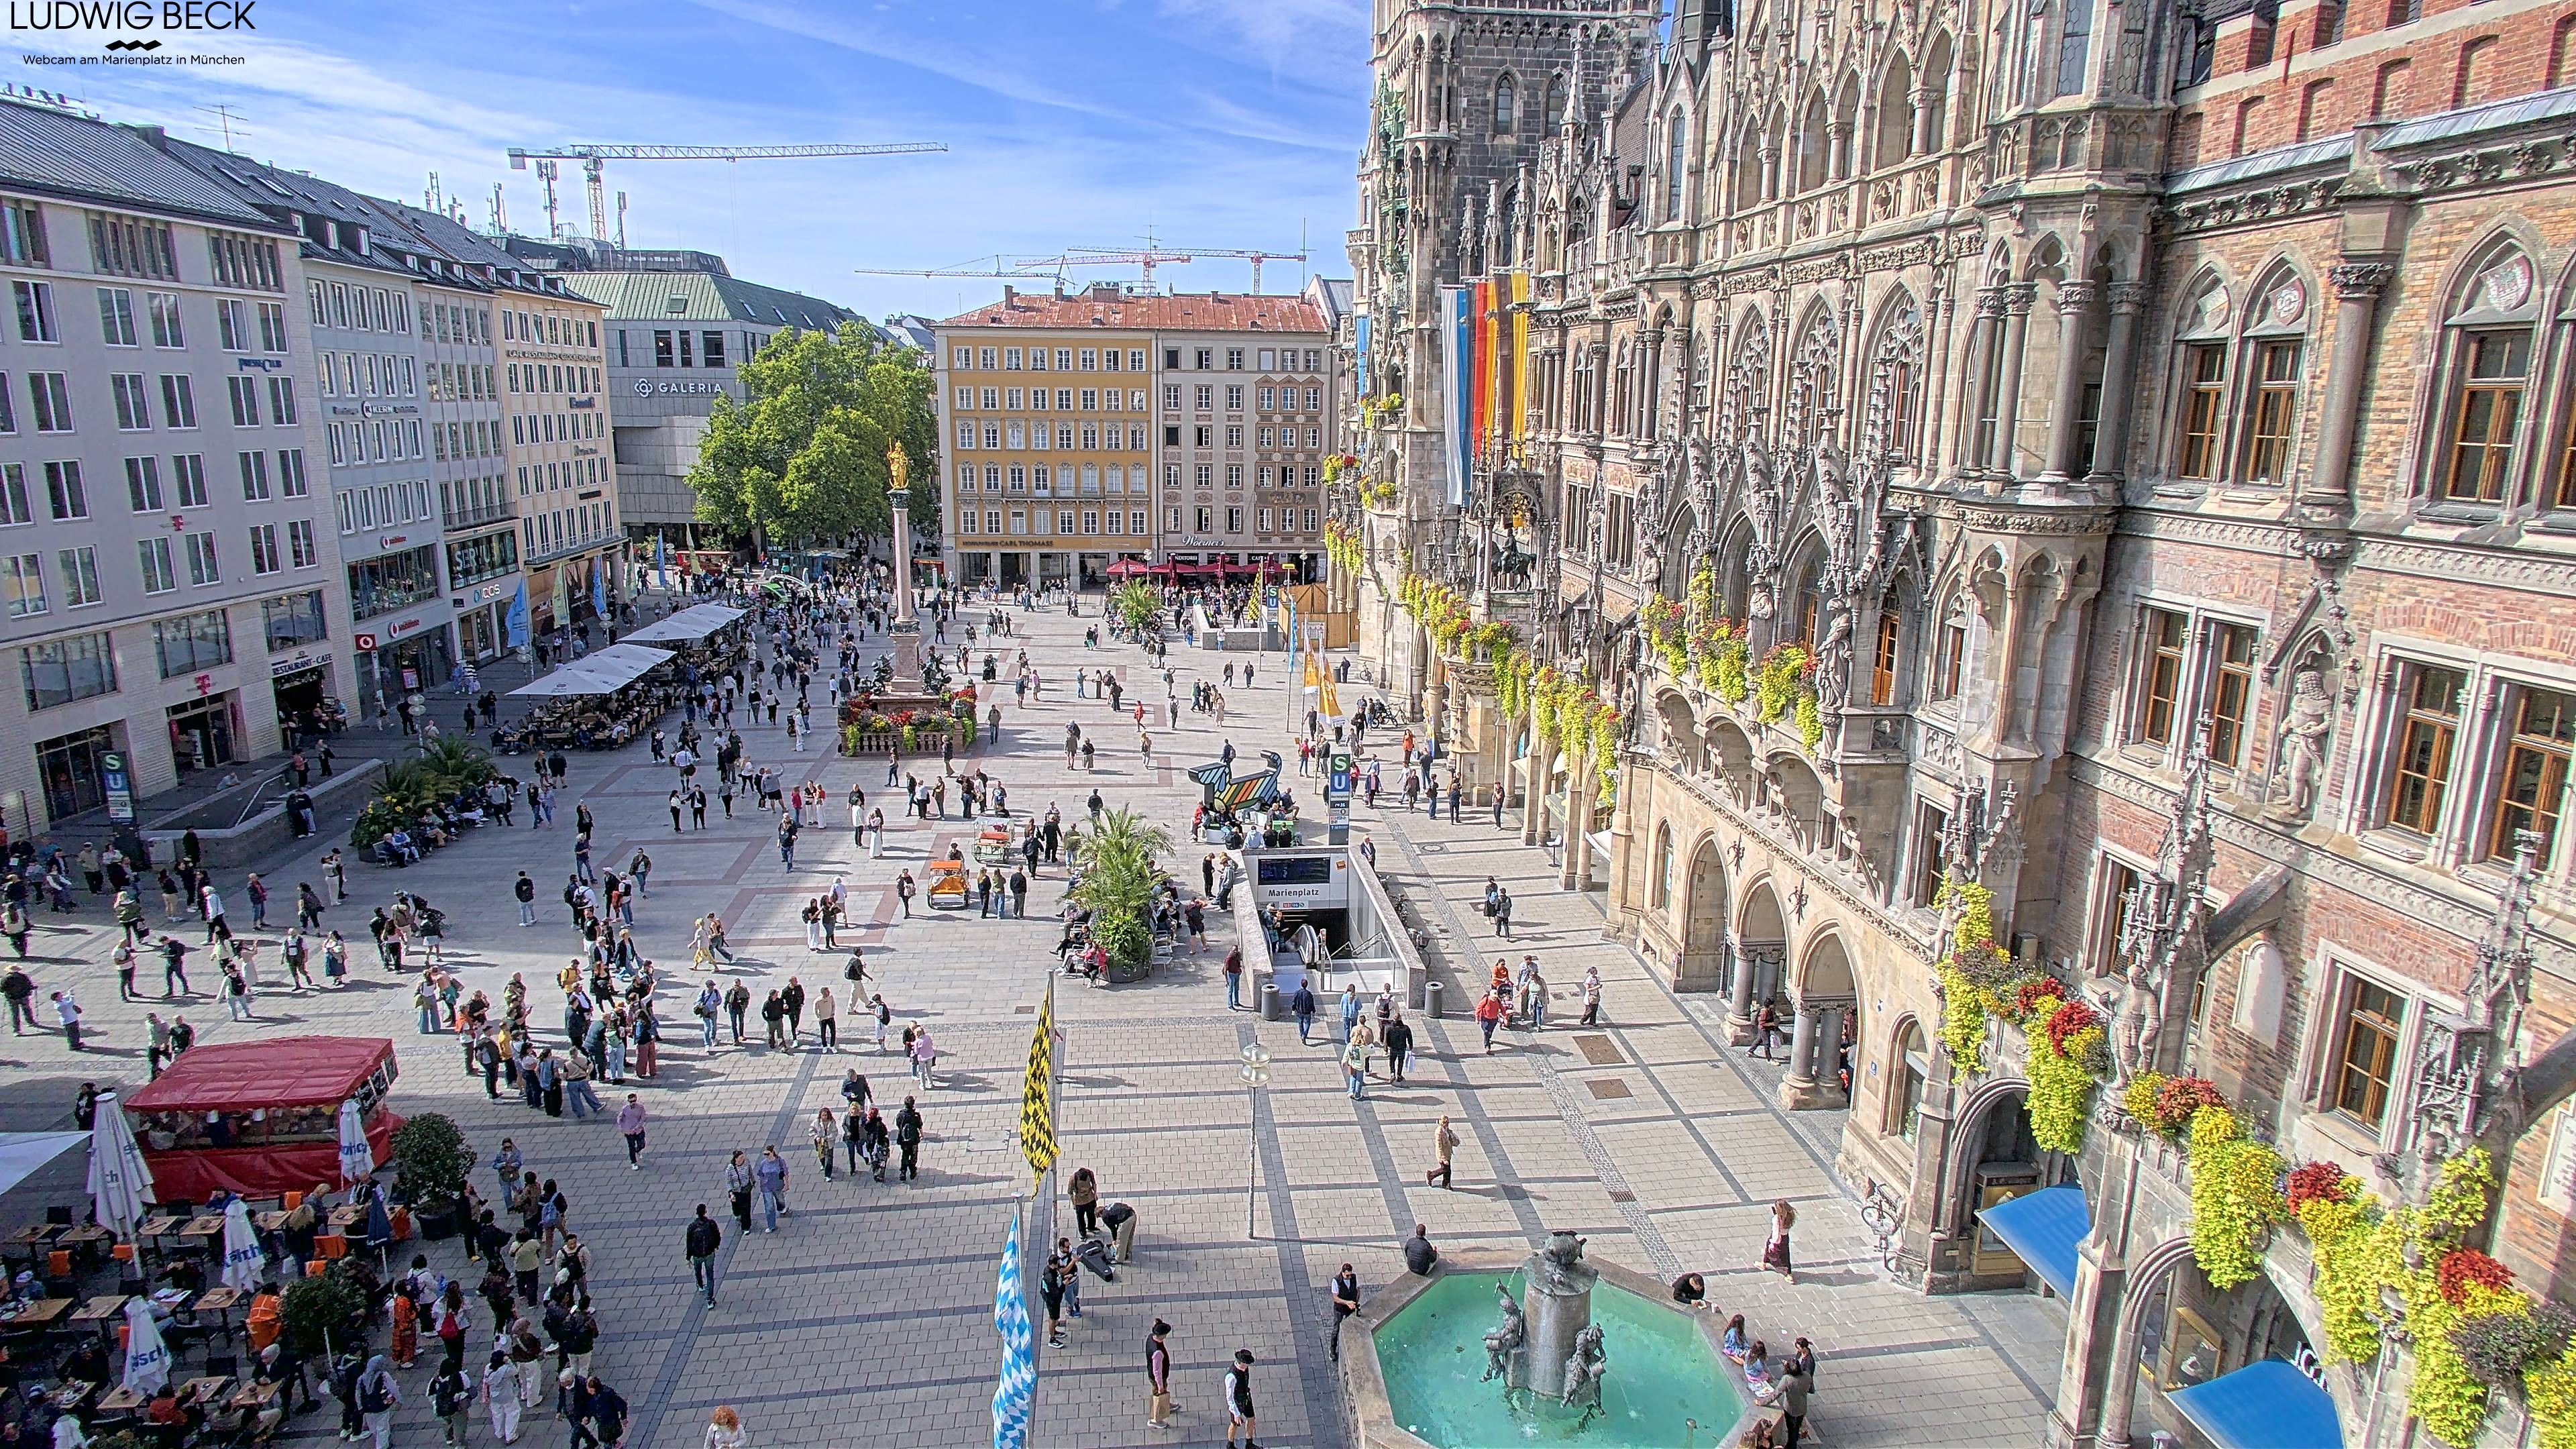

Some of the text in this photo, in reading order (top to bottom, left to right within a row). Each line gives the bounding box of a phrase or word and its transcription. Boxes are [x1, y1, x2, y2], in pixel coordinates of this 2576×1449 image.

[658, 382, 722, 393] GALERIA
[481, 584, 500, 599] IQOS
[1269, 588, 1277, 596] S
[1269, 598, 1277, 607] U
[105, 754, 121, 769] S
[1334, 756, 1346, 771] S
[108, 773, 122, 789] U
[1334, 775, 1346, 790] U
[1268, 888, 1320, 898] Marienplatz
